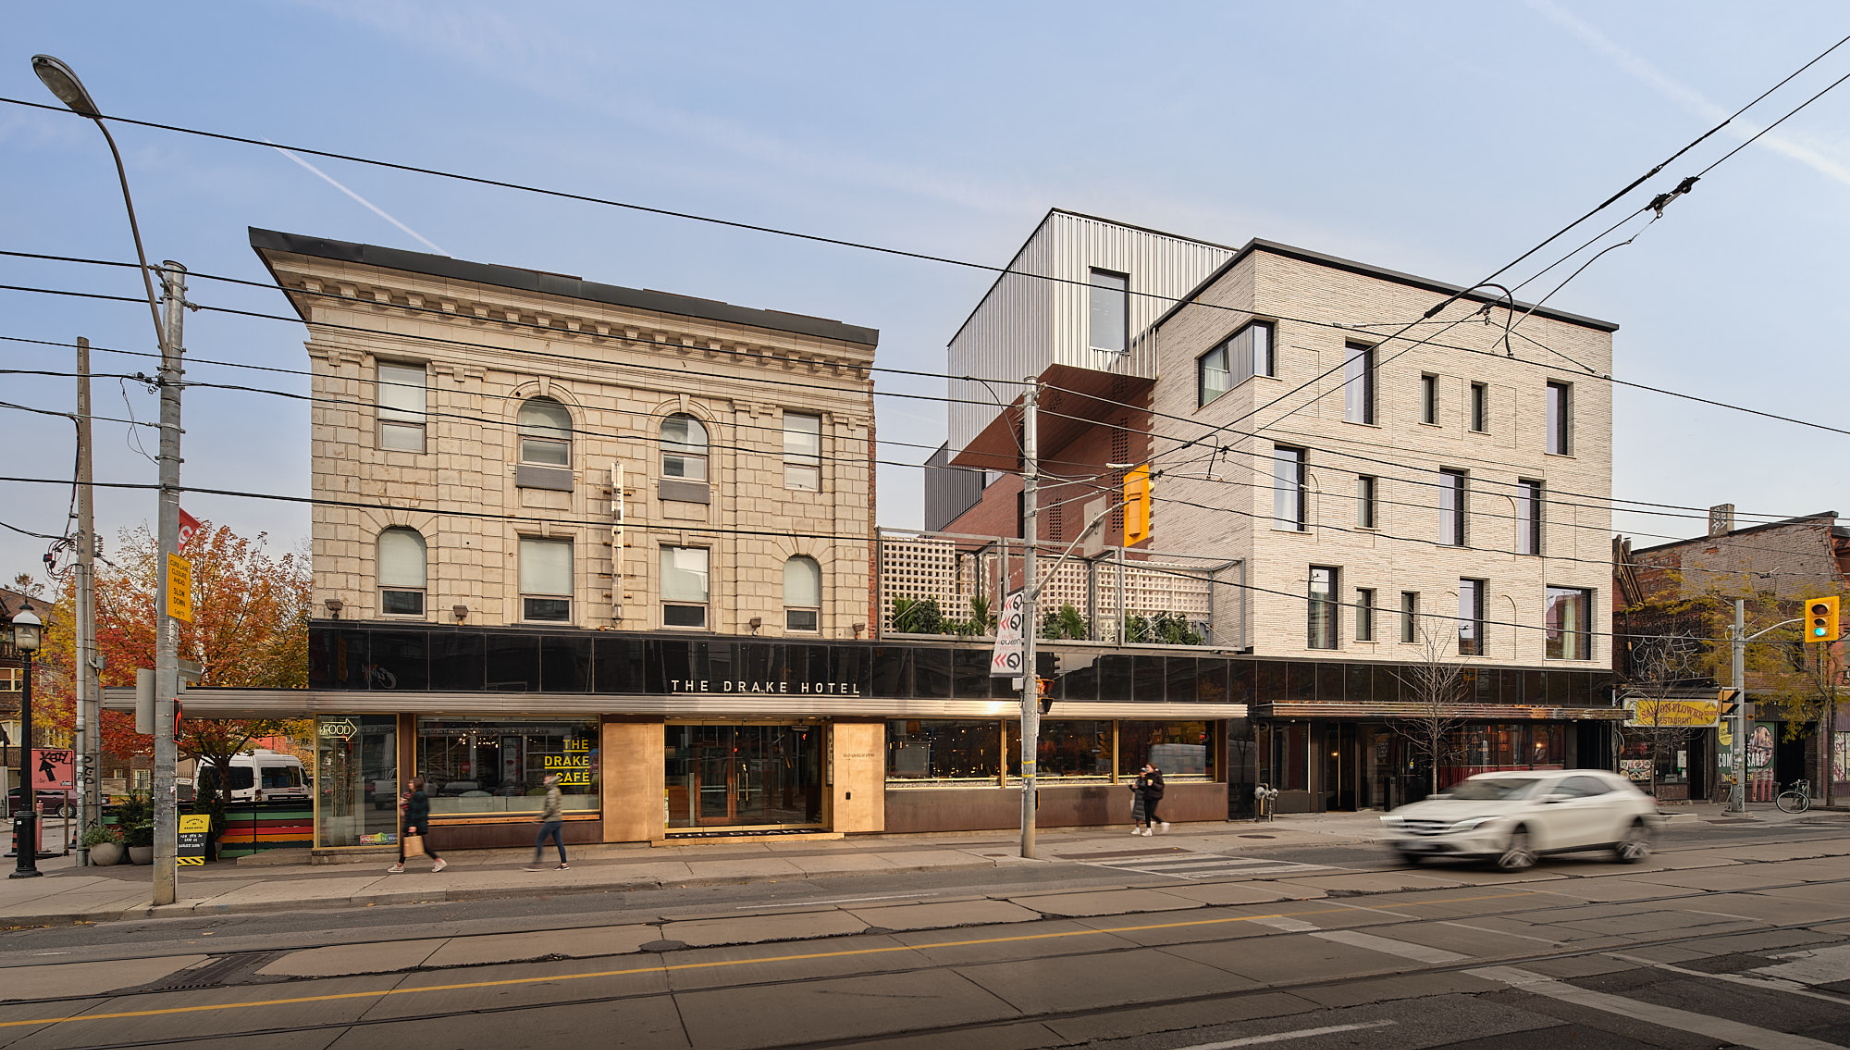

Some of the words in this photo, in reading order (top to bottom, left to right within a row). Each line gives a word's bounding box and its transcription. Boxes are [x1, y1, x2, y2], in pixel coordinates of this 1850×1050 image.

[172, 568, 187, 580] CLOSURE
[174, 577, 185, 587] AHEAD
[174, 587, 185, 597] SLOW
[174, 596, 185, 607] DOWN
[671, 680, 709, 692] THE
[723, 680, 788, 693] DRAKE
[801, 682, 860, 694] HOTEL
[1641, 703, 1671, 720] SAON
[323, 724, 351, 735] FOOD
[563, 739, 589, 750] THE
[544, 755, 590, 766] DRAKE
[555, 769, 590, 783] CAFÉ
